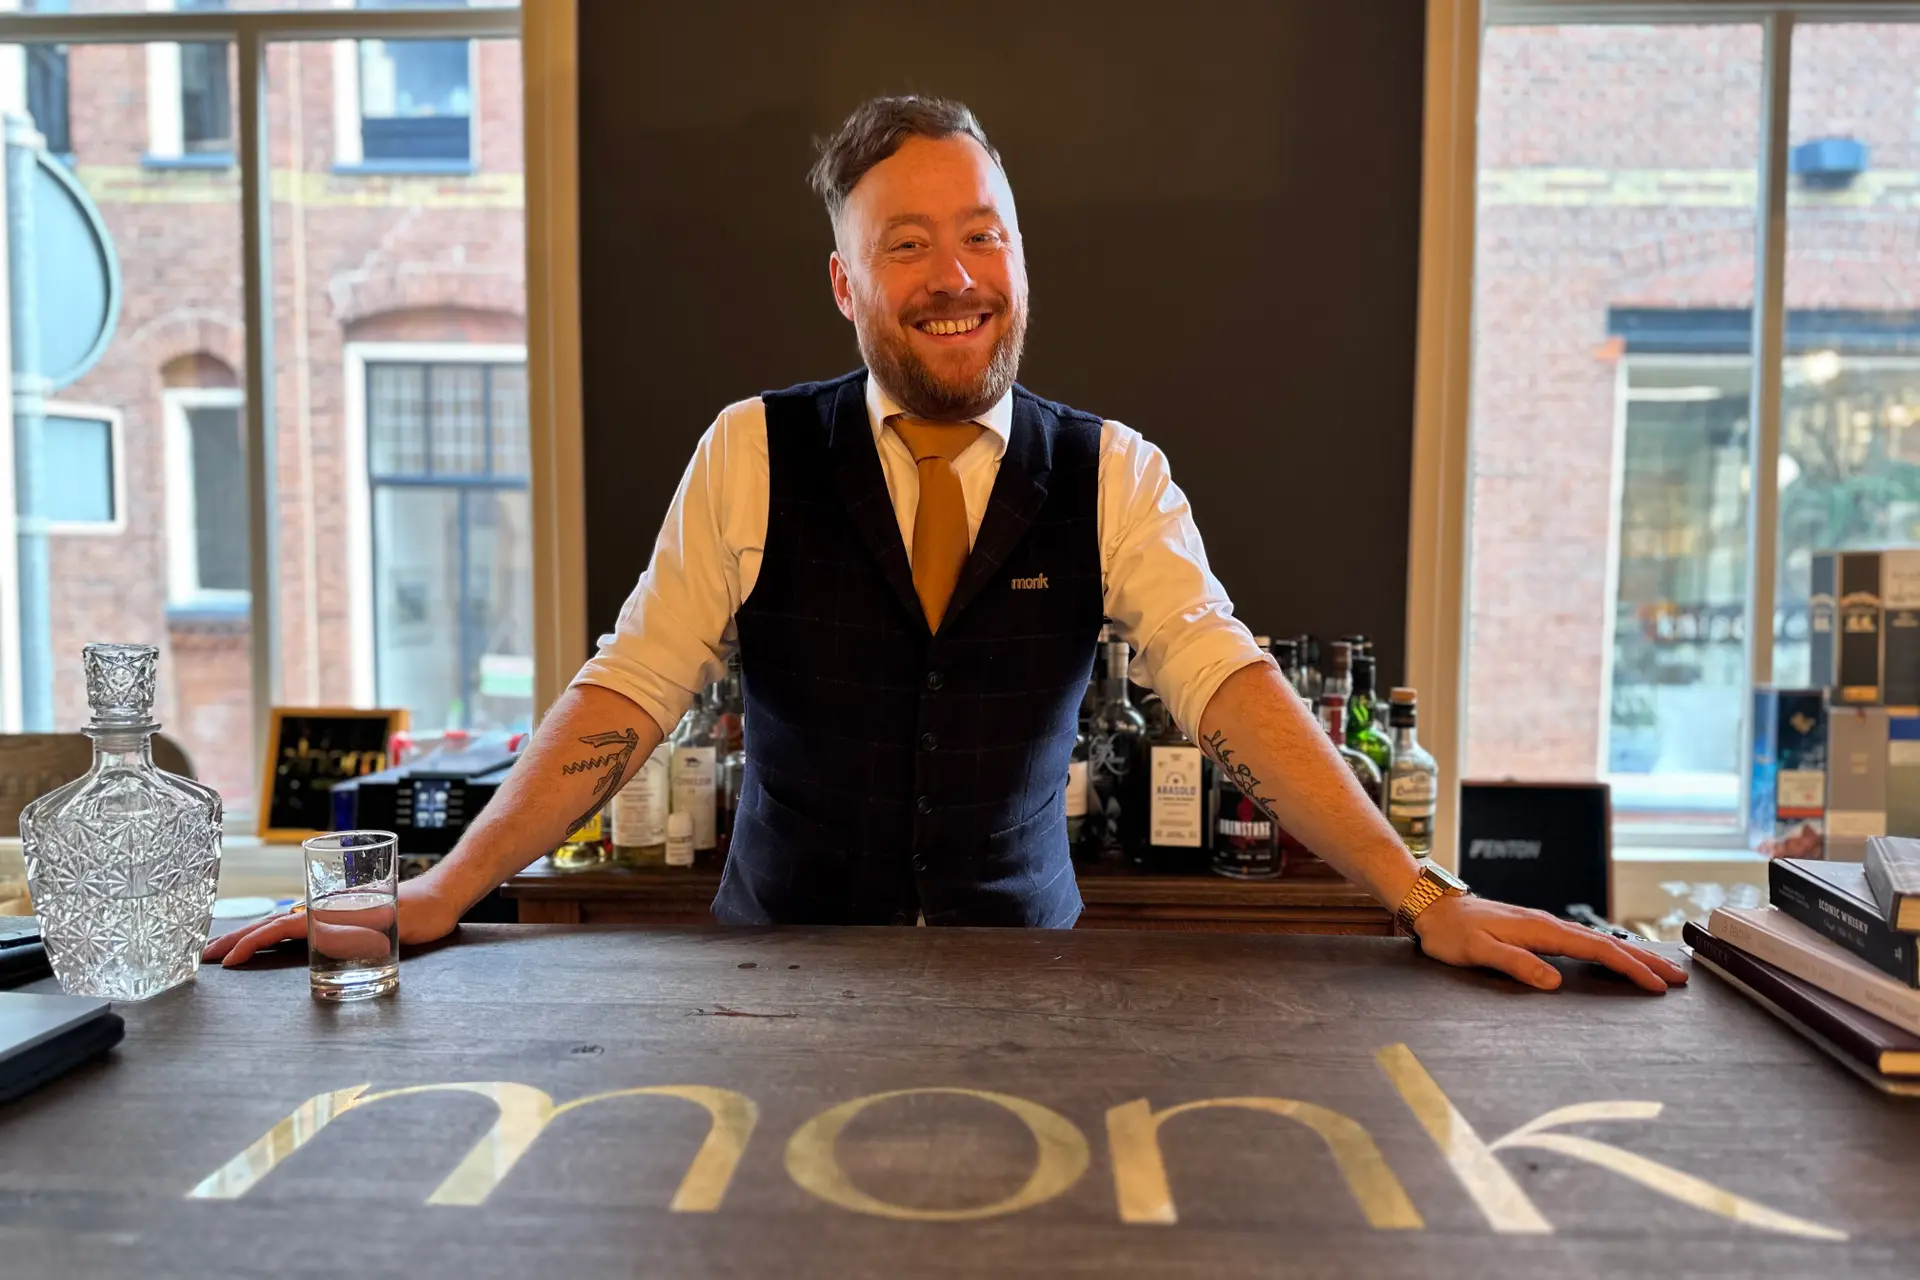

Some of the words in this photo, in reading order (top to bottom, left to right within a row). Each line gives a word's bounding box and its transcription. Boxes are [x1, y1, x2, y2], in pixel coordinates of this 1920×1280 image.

[1011, 573, 1049, 590] monk
[1818, 898, 1841, 920] ICONIC
[1841, 911, 1869, 935] WHISKY
[184, 1043, 1850, 1241] monk
